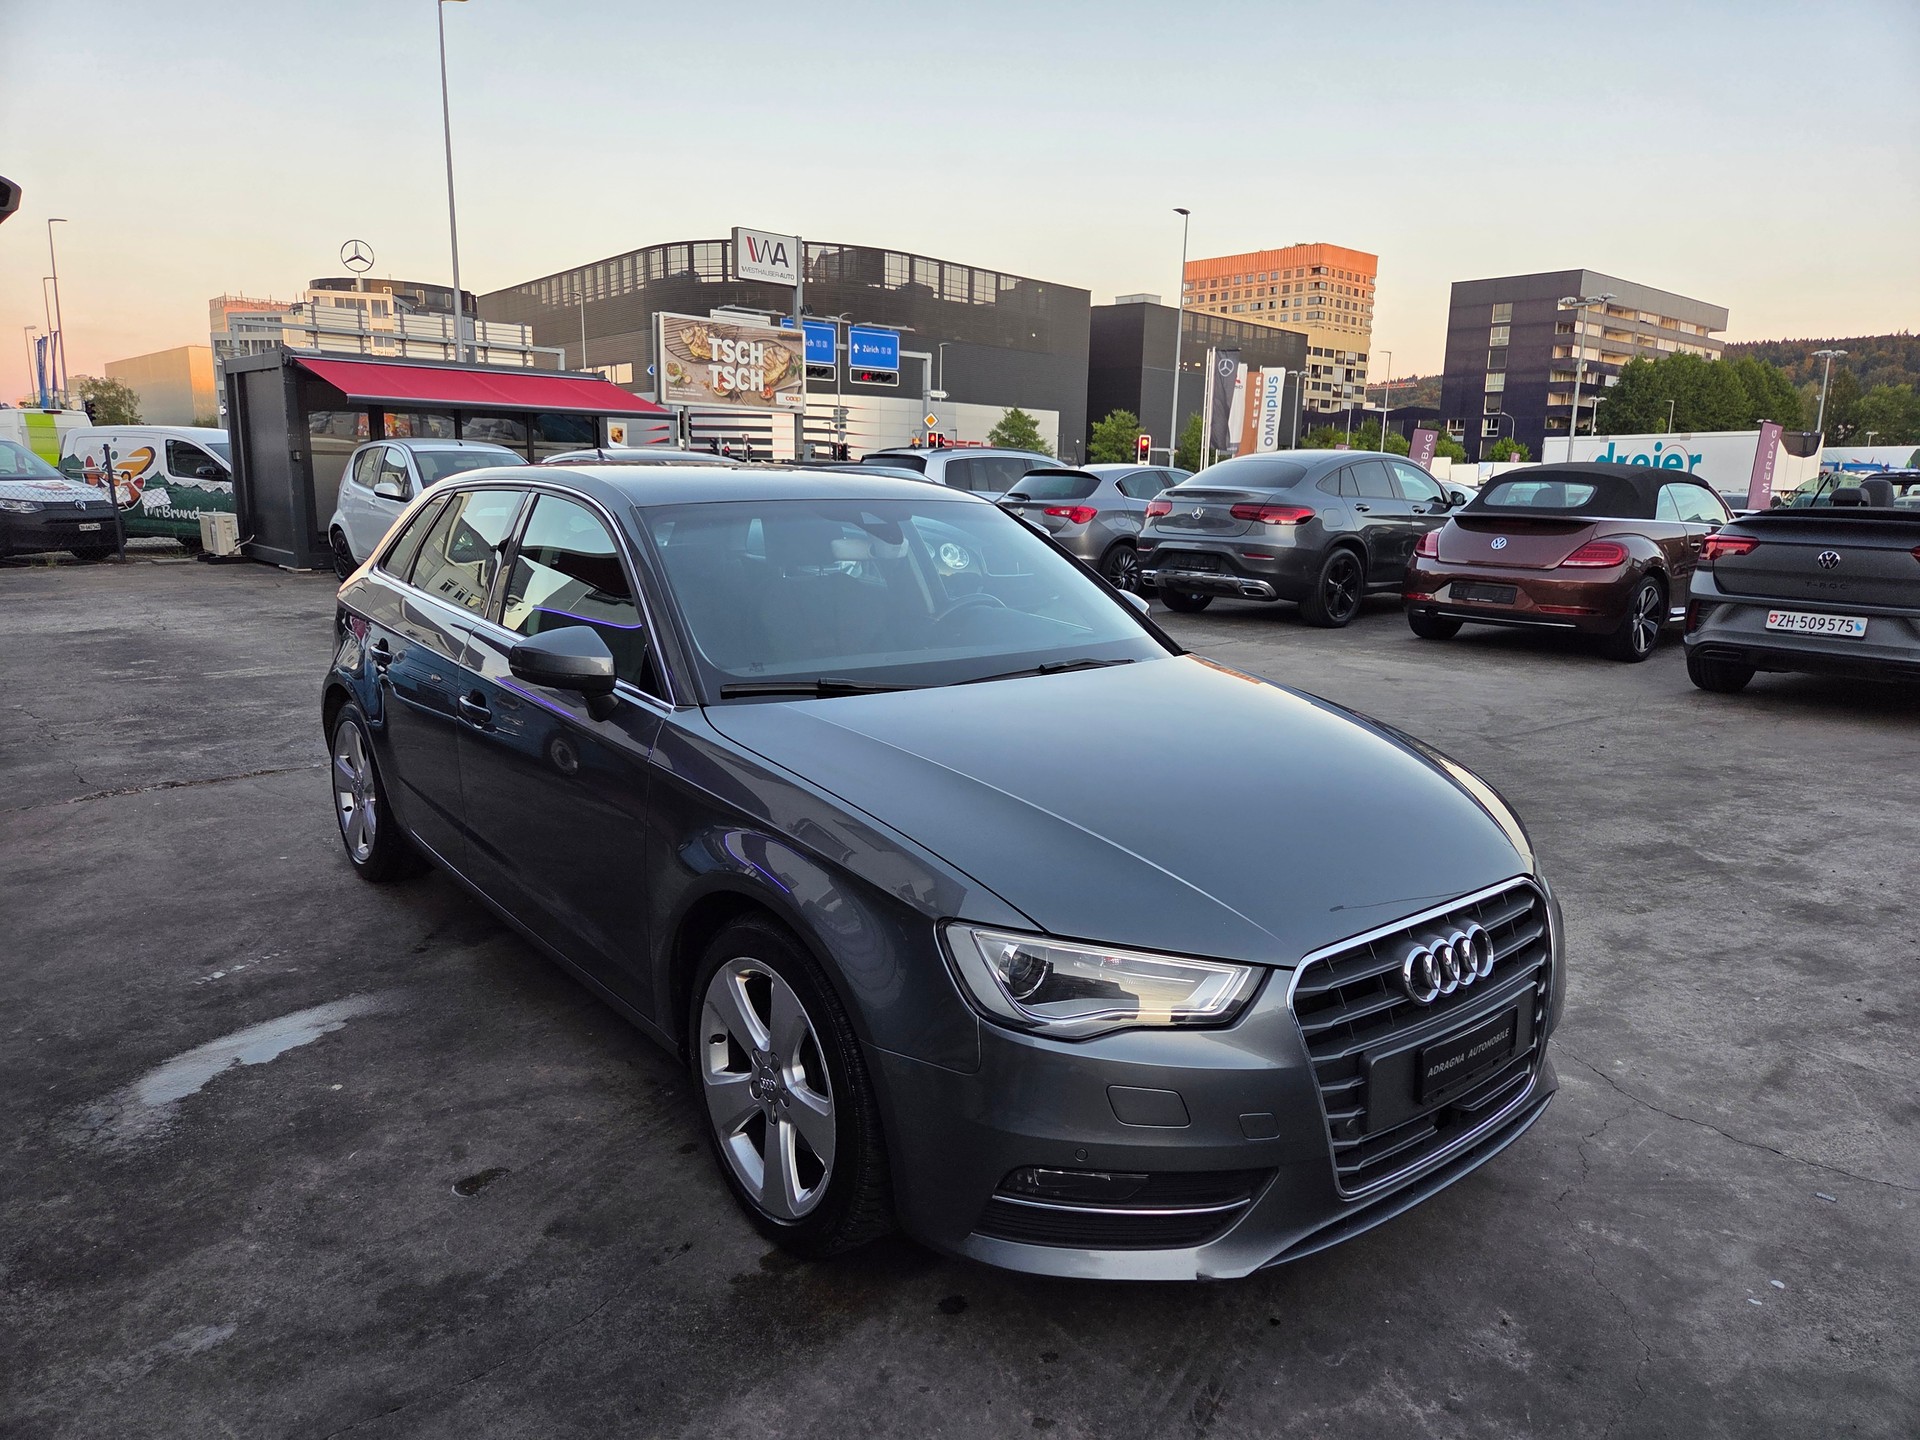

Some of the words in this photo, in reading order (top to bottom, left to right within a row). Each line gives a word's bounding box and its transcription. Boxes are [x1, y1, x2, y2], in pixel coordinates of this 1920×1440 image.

[708, 338, 764, 366] TSCH
[862, 344, 879, 354] Zürich
[708, 364, 764, 392] TSCH
[1251, 376, 1262, 429] SETRA
[1264, 375, 1278, 447] OMNIplus
[1419, 433, 1434, 469] RBAG
[1762, 429, 1777, 493] MERBAG
[1427, 1053, 1465, 1078] ADRAGNA
[1467, 1027, 1510, 1059] AUTOMOBILE
